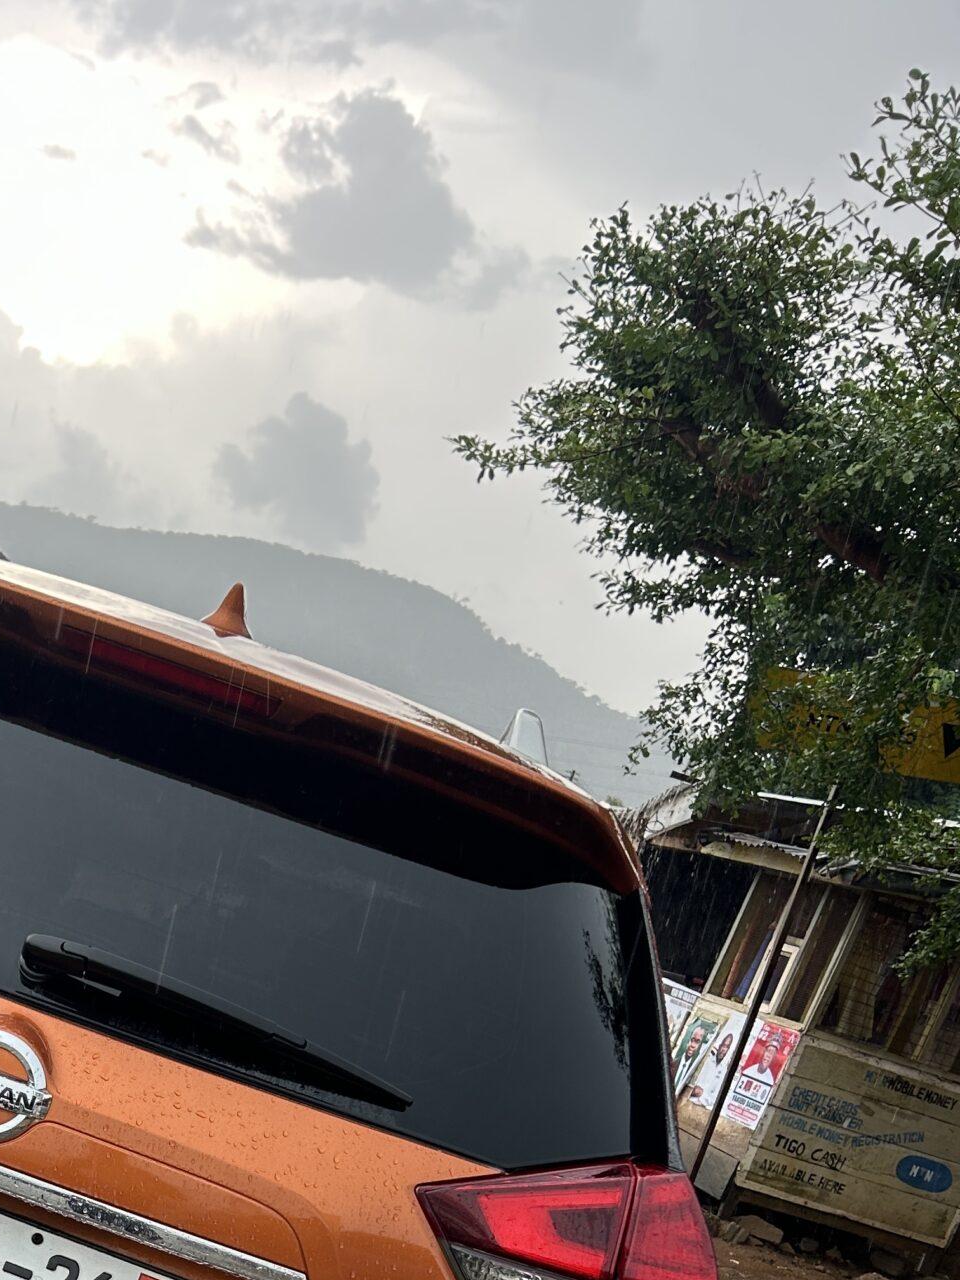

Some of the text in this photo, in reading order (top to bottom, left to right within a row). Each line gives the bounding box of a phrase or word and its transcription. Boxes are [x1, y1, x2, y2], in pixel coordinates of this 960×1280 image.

[792, 1087, 826, 1105] CREDIT
[779, 1113, 816, 1134] MOBILE
[851, 1131, 924, 1148] REGISTRATION
[775, 1134, 847, 1171] TIGO CASH
[819, 1176, 846, 1195] HERE
